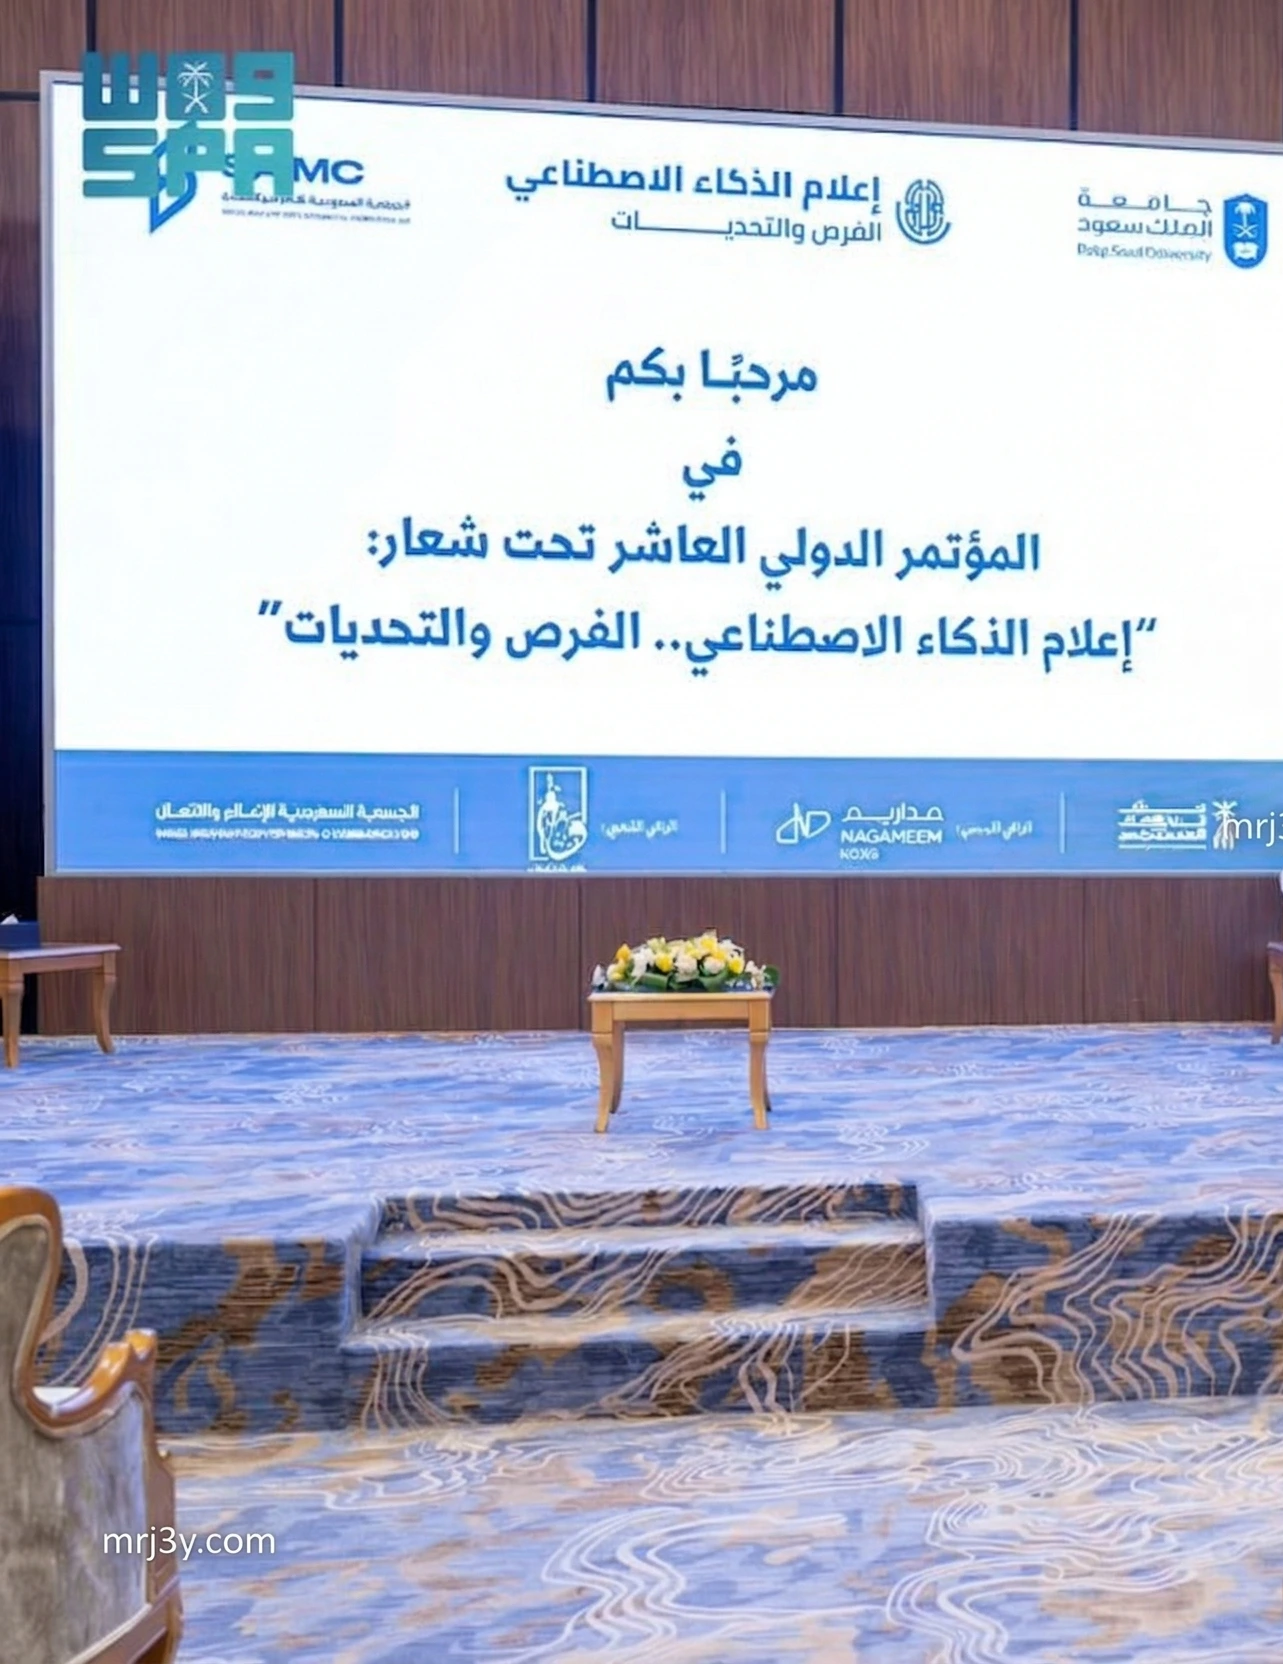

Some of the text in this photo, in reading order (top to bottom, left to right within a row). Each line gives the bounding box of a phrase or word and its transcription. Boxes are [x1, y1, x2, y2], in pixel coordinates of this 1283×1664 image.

[505, 158, 882, 216] إعلام الذكاء الاصطناعي
[811, 217, 882, 247] الفرص
[605, 346, 686, 403] بكم
[682, 435, 743, 502] في
[367, 514, 1040, 592] المؤتمر الدولي العاشر تحت شعار:
[505, 607, 641, 662] الفرص
[916, 615, 1029, 657] الذكاء
